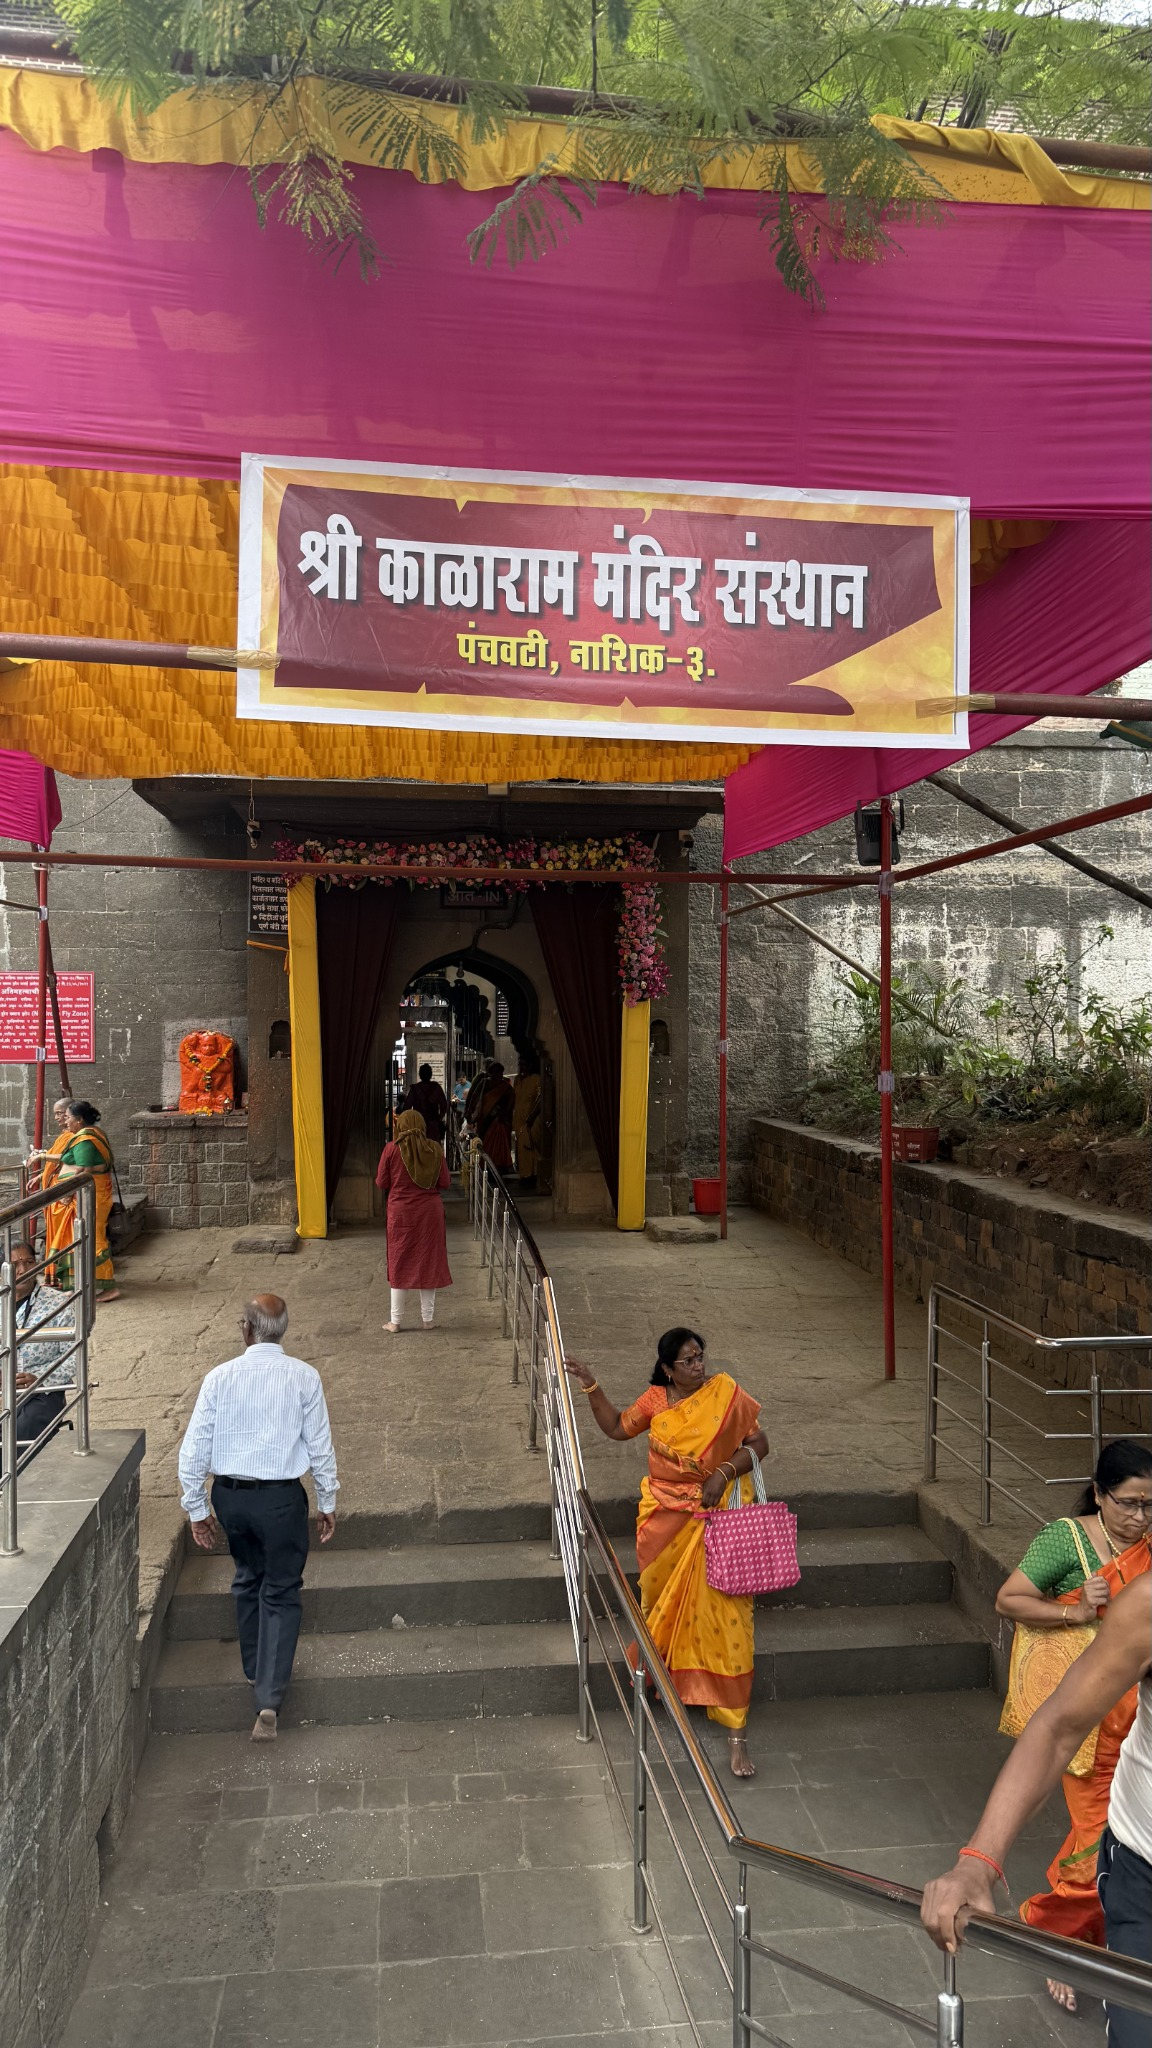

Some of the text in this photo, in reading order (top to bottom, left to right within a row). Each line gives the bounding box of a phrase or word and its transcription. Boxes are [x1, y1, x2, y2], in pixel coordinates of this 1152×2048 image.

[297, 513, 868, 631] श्री काळाराम मंदिर संस्थान
[457, 621, 558, 676] पंचवटी,
